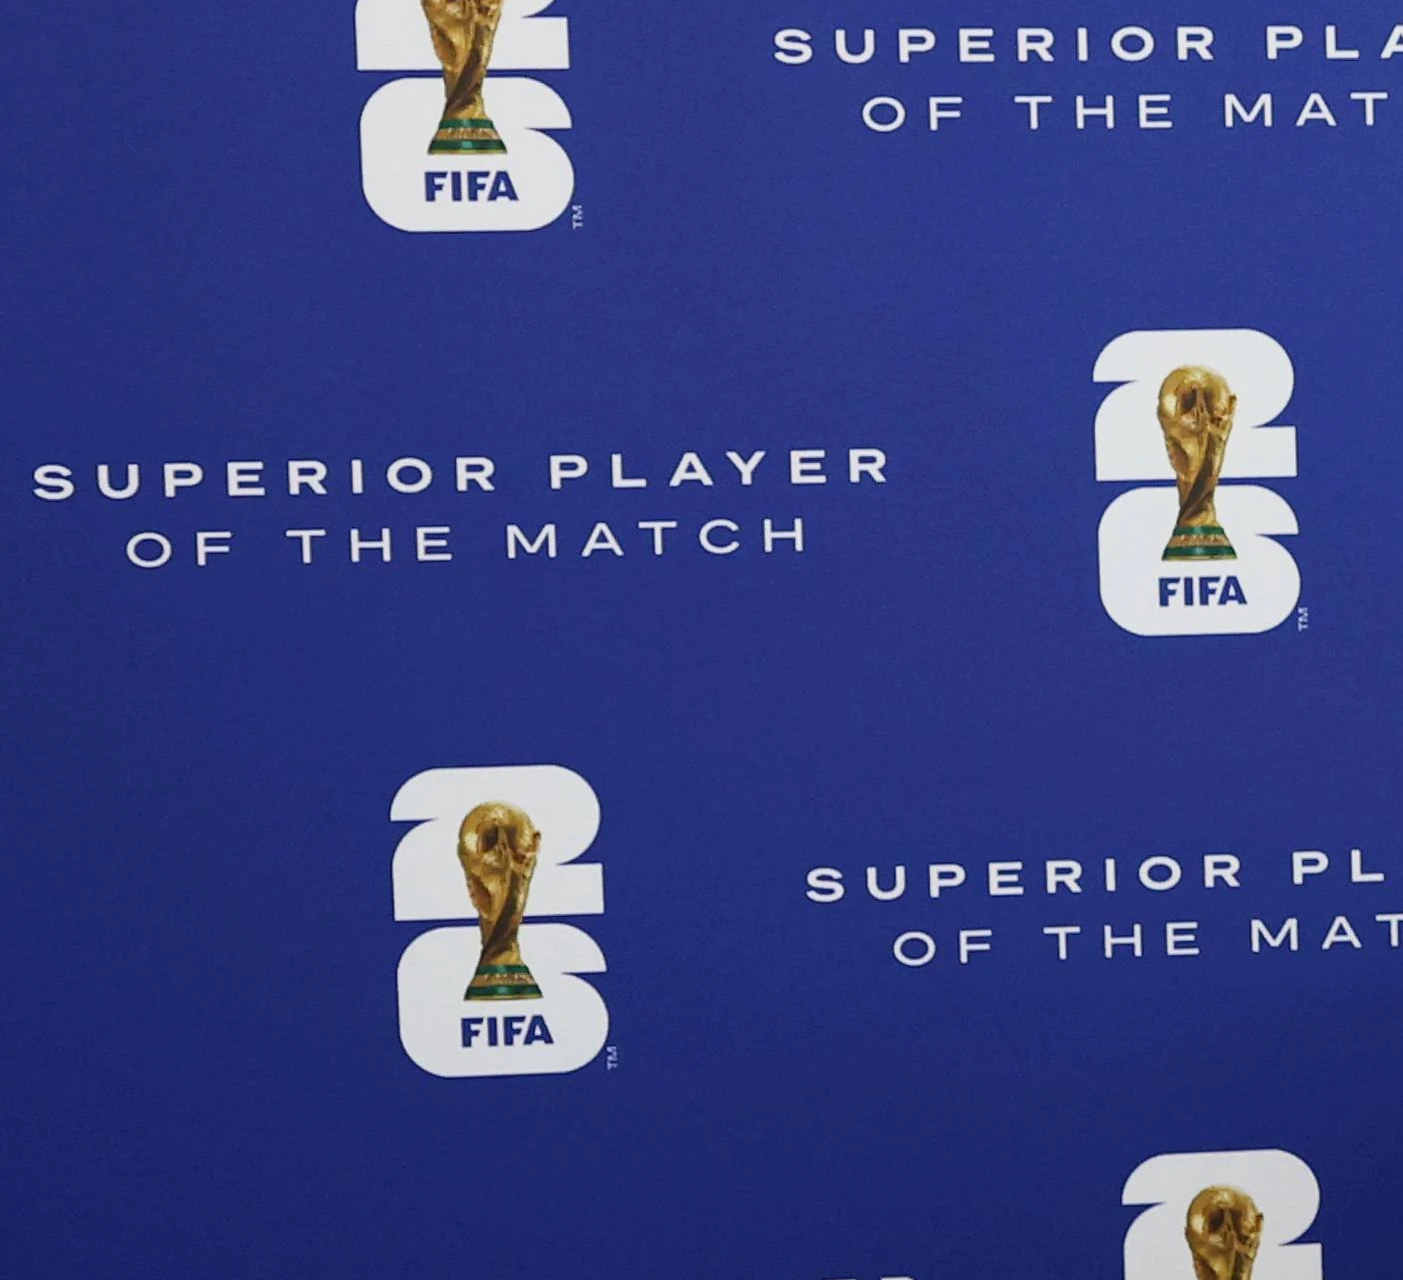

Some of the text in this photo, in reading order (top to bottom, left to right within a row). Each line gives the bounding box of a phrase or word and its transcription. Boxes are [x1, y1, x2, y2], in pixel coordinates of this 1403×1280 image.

[773, 25, 1214, 65] SUPERIOR
[861, 96, 964, 133] OF
[1013, 93, 1173, 131] THE
[423, 170, 519, 203] FIFA
[32, 448, 887, 501] SUPERIOR PLAYER
[126, 517, 804, 569] OF THE MATCH
[1157, 574, 1248, 608] FIFA
[806, 853, 1241, 903] SUPERIOR
[893, 928, 993, 967] OF
[1042, 921, 1200, 961] THE
[460, 1014, 555, 1049] FIFA
